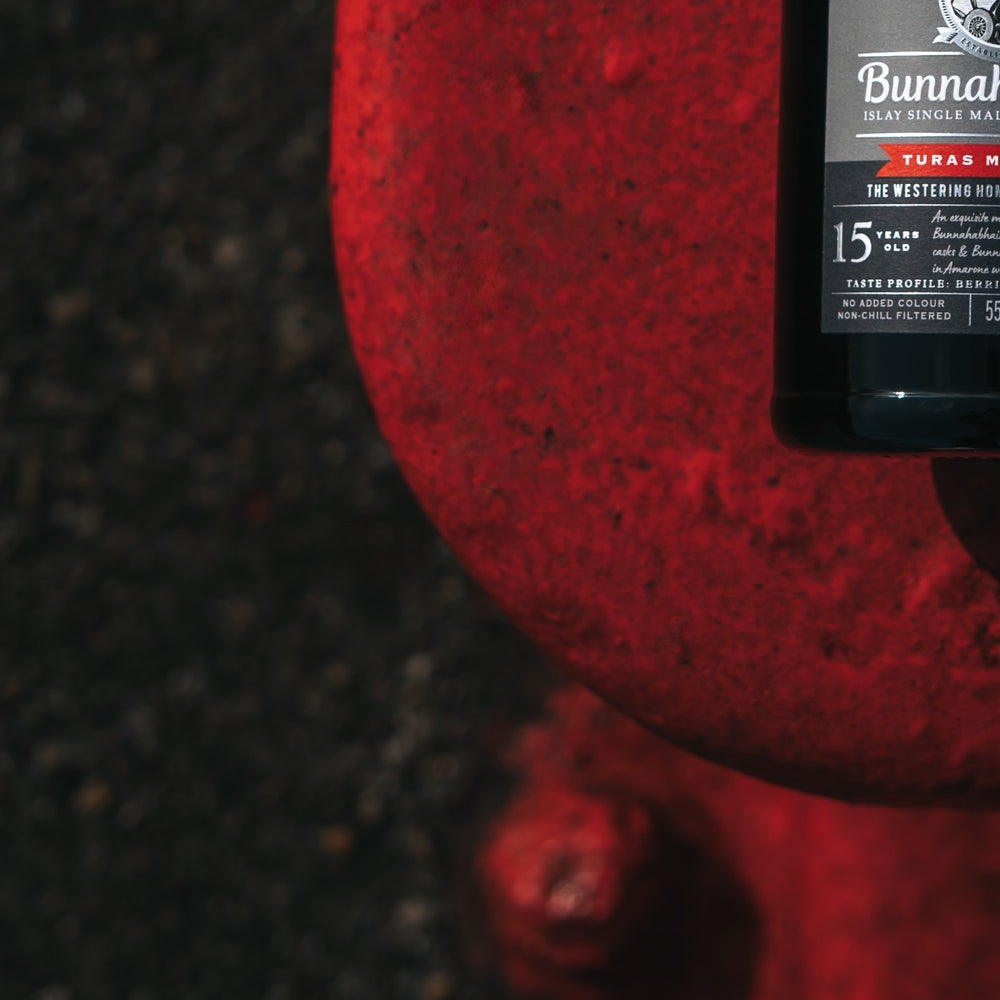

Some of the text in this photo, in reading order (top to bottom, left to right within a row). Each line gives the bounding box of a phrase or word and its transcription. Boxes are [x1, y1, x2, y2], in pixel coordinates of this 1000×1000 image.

[863, 110, 901, 121] ISLAY
[907, 109, 963, 120] SINGLE
[902, 154, 974, 166] TURAS
[867, 184, 889, 198] THE
[893, 183, 972, 199] WESTERING
[931, 209, 948, 224] An
[949, 211, 990, 226] exquisite
[875, 230, 920, 239] YEARS
[832, 221, 873, 263] 15
[883, 243, 911, 252] OLD
[932, 245, 957, 258] casks
[958, 245, 968, 258] &
[932, 264, 943, 275] in
[942, 260, 991, 275] Amarone
[846, 279, 882, 288] TASTE
[887, 279, 950, 289] PROFILE:
[842, 299, 945, 308] NO ADDED COLOUR
[837, 311, 951, 321] NON-CHILL FILTERED
